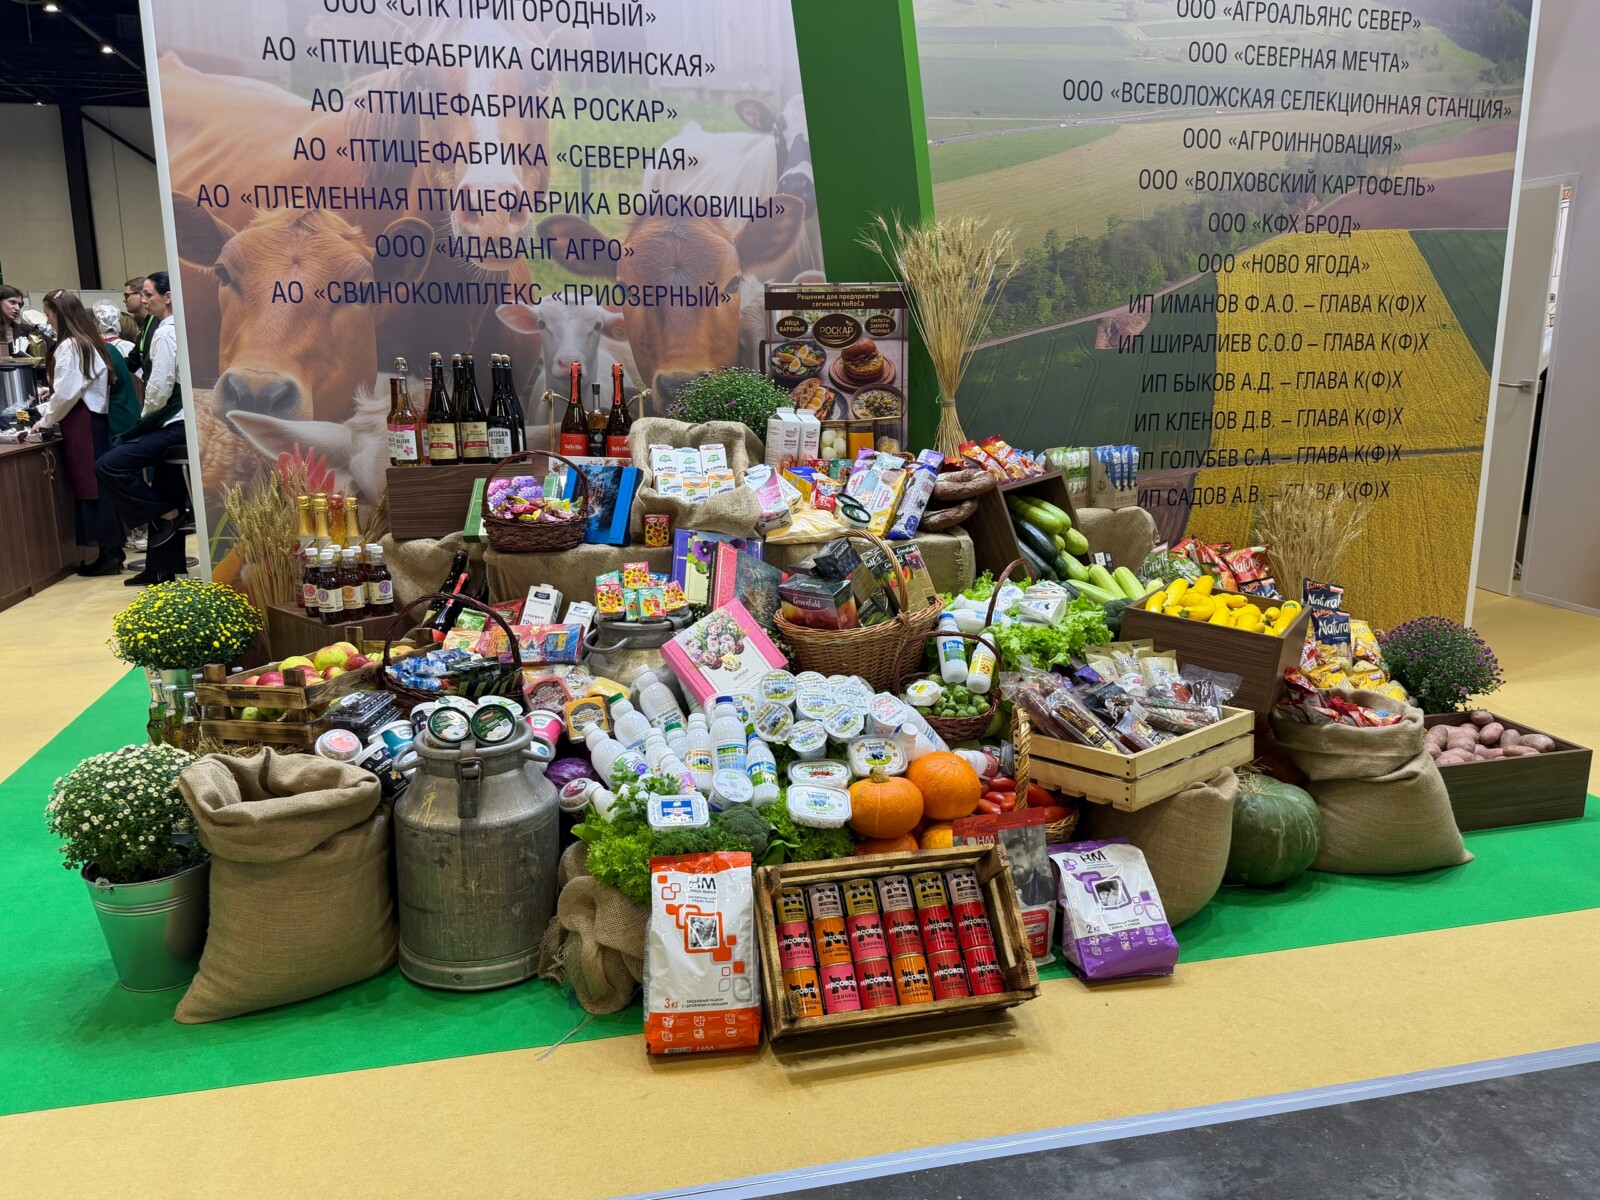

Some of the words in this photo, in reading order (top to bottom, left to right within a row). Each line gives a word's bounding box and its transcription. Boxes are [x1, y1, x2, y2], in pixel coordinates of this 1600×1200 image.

[458, 0, 656, 28] ПРИГОРОДНЫЙ»
[1223, 2, 1353, 27] «АГРОАЛЬЯНС
[1358, 9, 1421, 31] СЕВЕР»
[262, 37, 296, 61] АО
[306, 38, 523, 72] «ПТИЦЕФАБРИКА
[530, 47, 715, 77] СИНЯВИНСКАЯ»
[1188, 41, 1227, 64] ООО
[1234, 45, 1337, 70] «СЕВЕРНАЯ
[1342, 50, 1410, 74] МЕЧТА»
[311, 89, 344, 113] АО
[353, 90, 566, 120] «ПТИЦЕФАБРИКА
[573, 96, 677, 122] РОСКАР»
[1063, 79, 1103, 102] ООО
[1110, 81, 1275, 109] «ВСЕВОЛОЖСКАЯ
[1280, 90, 1421, 117] СЕЛЕКЦИОННАЯ
[1426, 95, 1511, 121] СТАНЦИЯ»
[293, 137, 326, 161] АО
[336, 138, 548, 168] «ПТИЦЕФАБРИКА
[556, 142, 698, 171] «СЕВЕРНАЯ»
[1183, 128, 1221, 150] ООО
[1228, 131, 1402, 157] «АГРОИННОВАЦИЯ»
[1139, 169, 1178, 190] ООО
[1184, 170, 1316, 194] «ВОЛХОВСКИЙ
[1322, 173, 1435, 197] КАРТОФЕЛЬ»
[197, 184, 230, 208] АО
[240, 185, 408, 212] «ПЛЕМЕННАЯ
[416, 188, 610, 217] ПТИЦЕФАБРИКА
[617, 187, 785, 221] ВОЙСКОВИЦЫ»
[1208, 213, 1246, 233] ООО
[1252, 214, 1299, 235] «КФХ
[1304, 213, 1361, 237] БРОД»
[375, 235, 426, 259] ООО
[435, 236, 555, 265] «ИДАВАНГ
[565, 239, 634, 263] АГРО»
[1198, 254, 1235, 273] ООО
[1242, 254, 1298, 274] «НОВО
[1305, 253, 1370, 276] ЯГОДА»
[271, 281, 304, 304] АО
[313, 281, 543, 306] «СВИНОКОМПЛЕКС
[551, 281, 731, 308] «ПРИОЗЕРНЫЙ»
[1129, 294, 1154, 314] ИП
[1161, 294, 1239, 314] ИМАНОВ
[1245, 293, 1298, 314] Ф.А.О.
[1319, 293, 1373, 313] ГЛАВА
[1377, 293, 1426, 317] К(Ф)Х
[819, 326, 854, 335] РОСКАР
[1119, 334, 1144, 354] ИП
[1150, 333, 1252, 354] ШИРАЛИЕВ
[1258, 332, 1302, 352] С.О.О
[1323, 331, 1376, 351] ГЛАВА
[1380, 330, 1429, 353] К(Ф)Х
[1142, 373, 1167, 393] ИП
[1173, 372, 1235, 392] БЫКОВ
[1241, 372, 1274, 395] А.Д.
[1295, 371, 1349, 390] ГЛАВА
[1353, 370, 1402, 391] К(Ф)Х
[1135, 412, 1160, 431] ИП
[1166, 411, 1236, 431] КЛЕНОВ
[1242, 411, 1275, 432] Д.В.
[1296, 409, 1349, 429] ГЛАВА
[1353, 407, 1403, 429] К(Ф)Х
[1161, 449, 1238, 468] ГОЛУБЕВ
[1243, 448, 1275, 467] С.А.
[1296, 446, 1349, 465] ГЛАВА
[1353, 444, 1402, 465] К(Ф)Х
[1137, 488, 1161, 507] ИП
[1167, 486, 1227, 506] САДОВ
[1232, 485, 1263, 504] А.В.
[1080, 850, 1107, 863] НМ
[1086, 924, 1093, 934] 2
[664, 997, 671, 1009] 3
